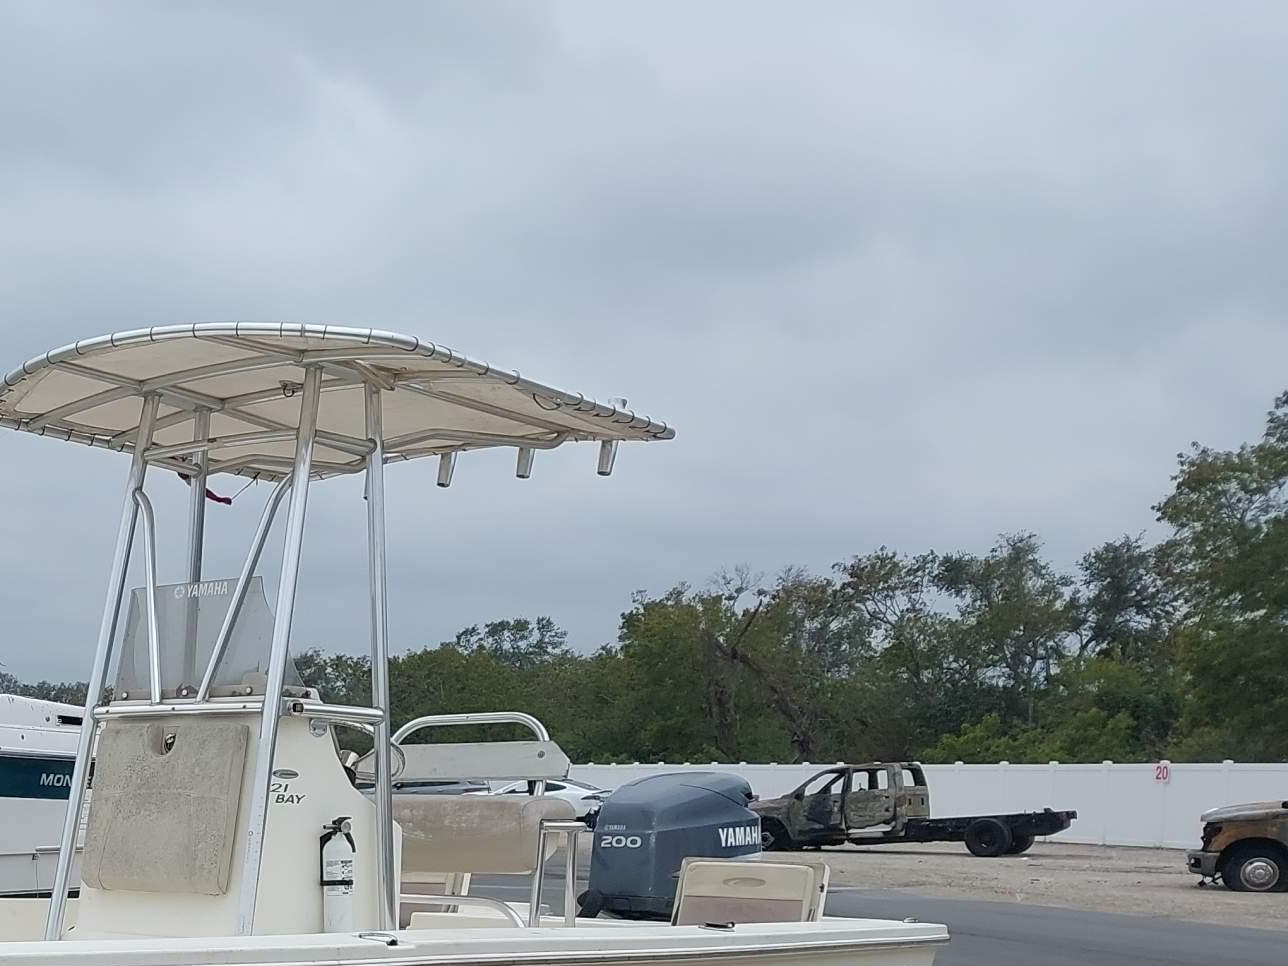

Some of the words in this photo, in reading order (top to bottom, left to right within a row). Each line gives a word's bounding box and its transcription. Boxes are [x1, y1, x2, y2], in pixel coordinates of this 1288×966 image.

[187, 582, 228, 598] YAMAHA
[1156, 766, 1168, 780] 20
[270, 783, 289, 793] 21
[275, 794, 306, 804] BAY
[600, 835, 642, 848] 200
